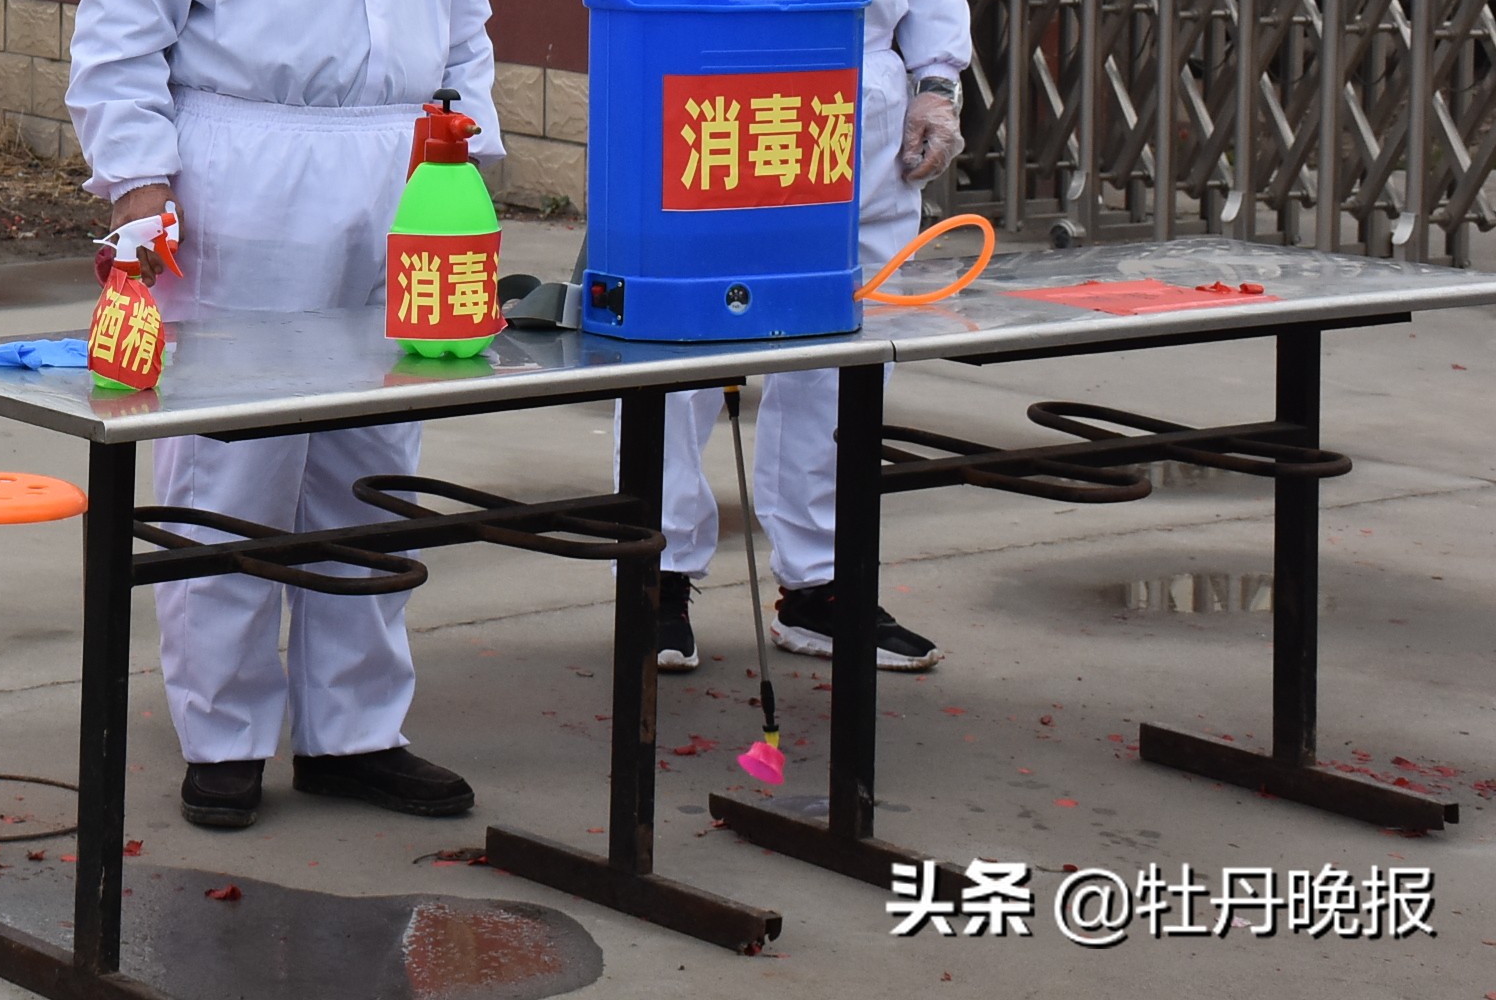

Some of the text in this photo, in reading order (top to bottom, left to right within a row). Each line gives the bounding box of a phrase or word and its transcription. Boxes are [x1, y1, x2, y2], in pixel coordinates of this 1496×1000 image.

[680, 91, 855, 190] 消毒液
[88, 286, 161, 375] 酒精
